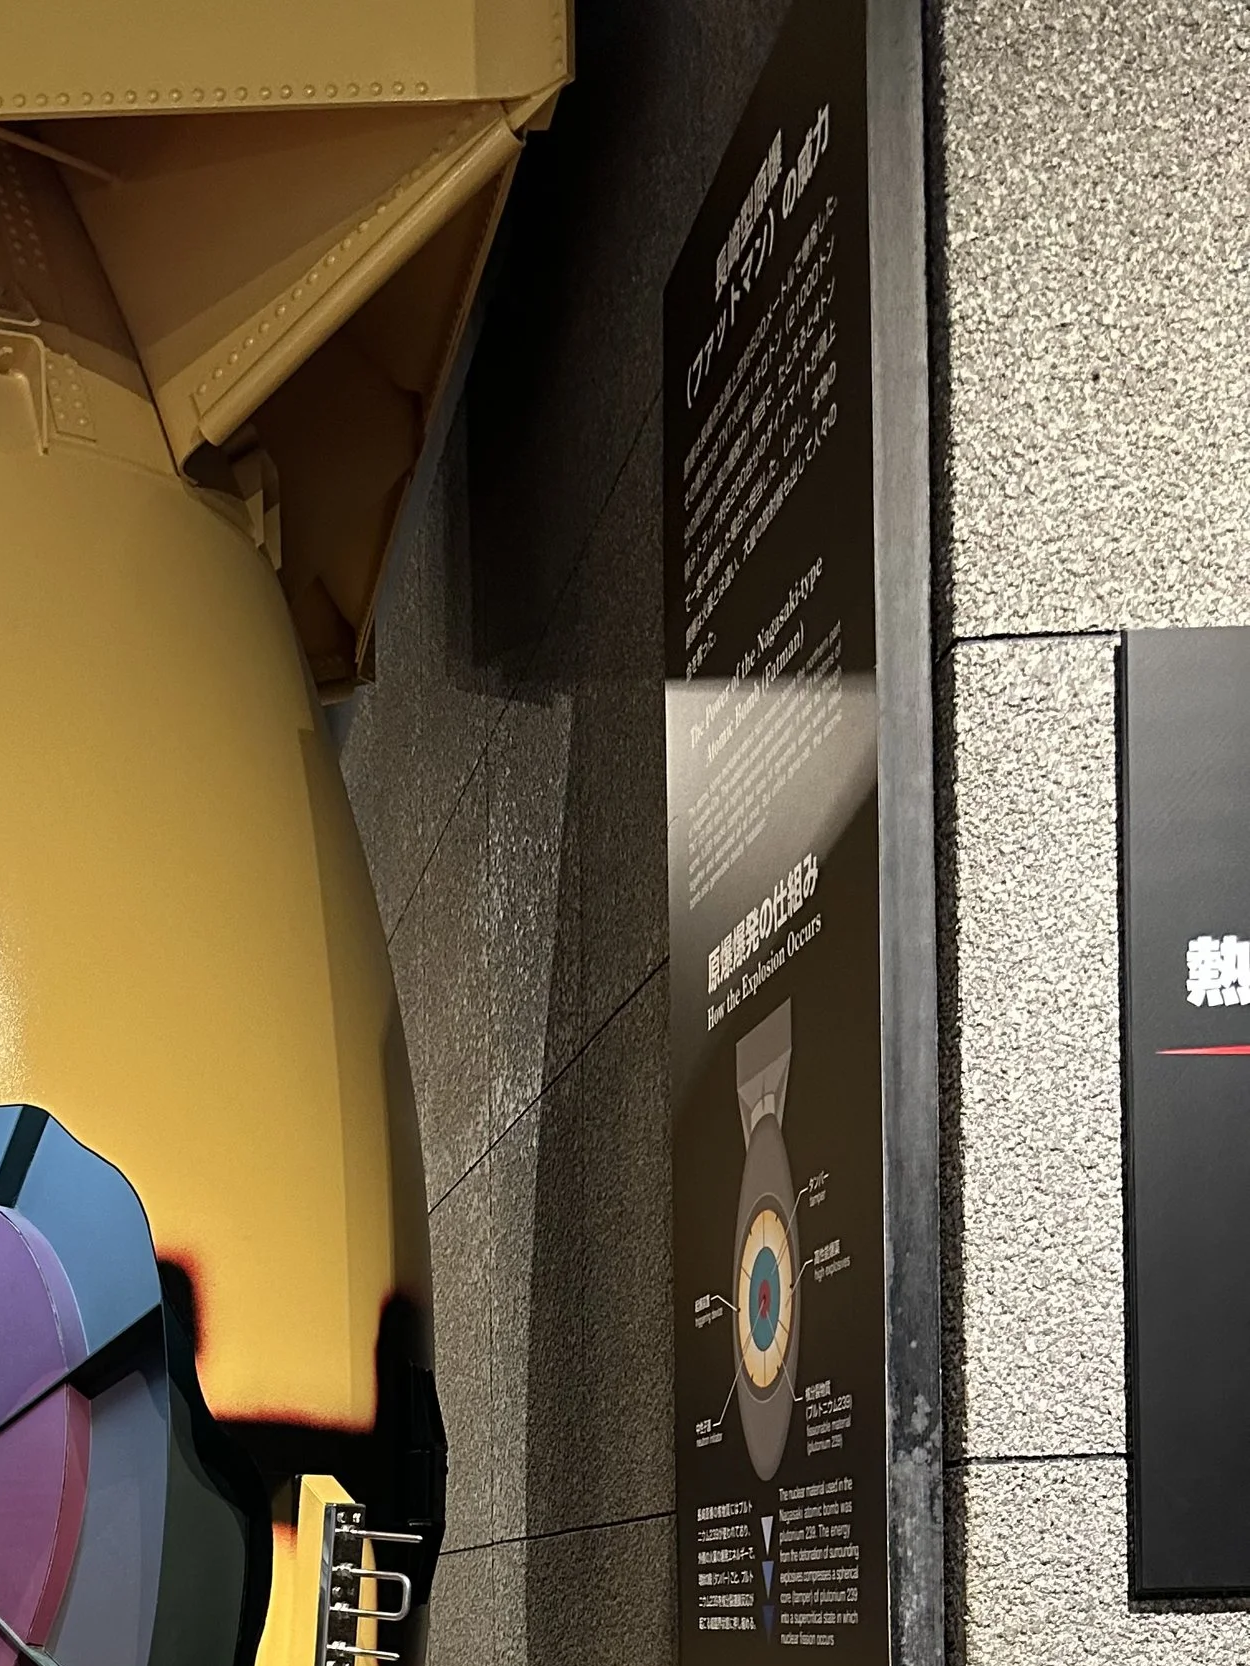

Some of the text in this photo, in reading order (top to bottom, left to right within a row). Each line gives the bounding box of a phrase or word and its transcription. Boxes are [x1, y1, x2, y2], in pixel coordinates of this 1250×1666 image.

[714, 128, 783, 303] 長崎型原爆
[756, 556, 823, 659] Nagasaki-type
[761, 620, 804, 701] (Fatman)
[707, 851, 820, 995] 原爆爆発の仕組み
[707, 913, 822, 1032] How the Explosion Occurs
